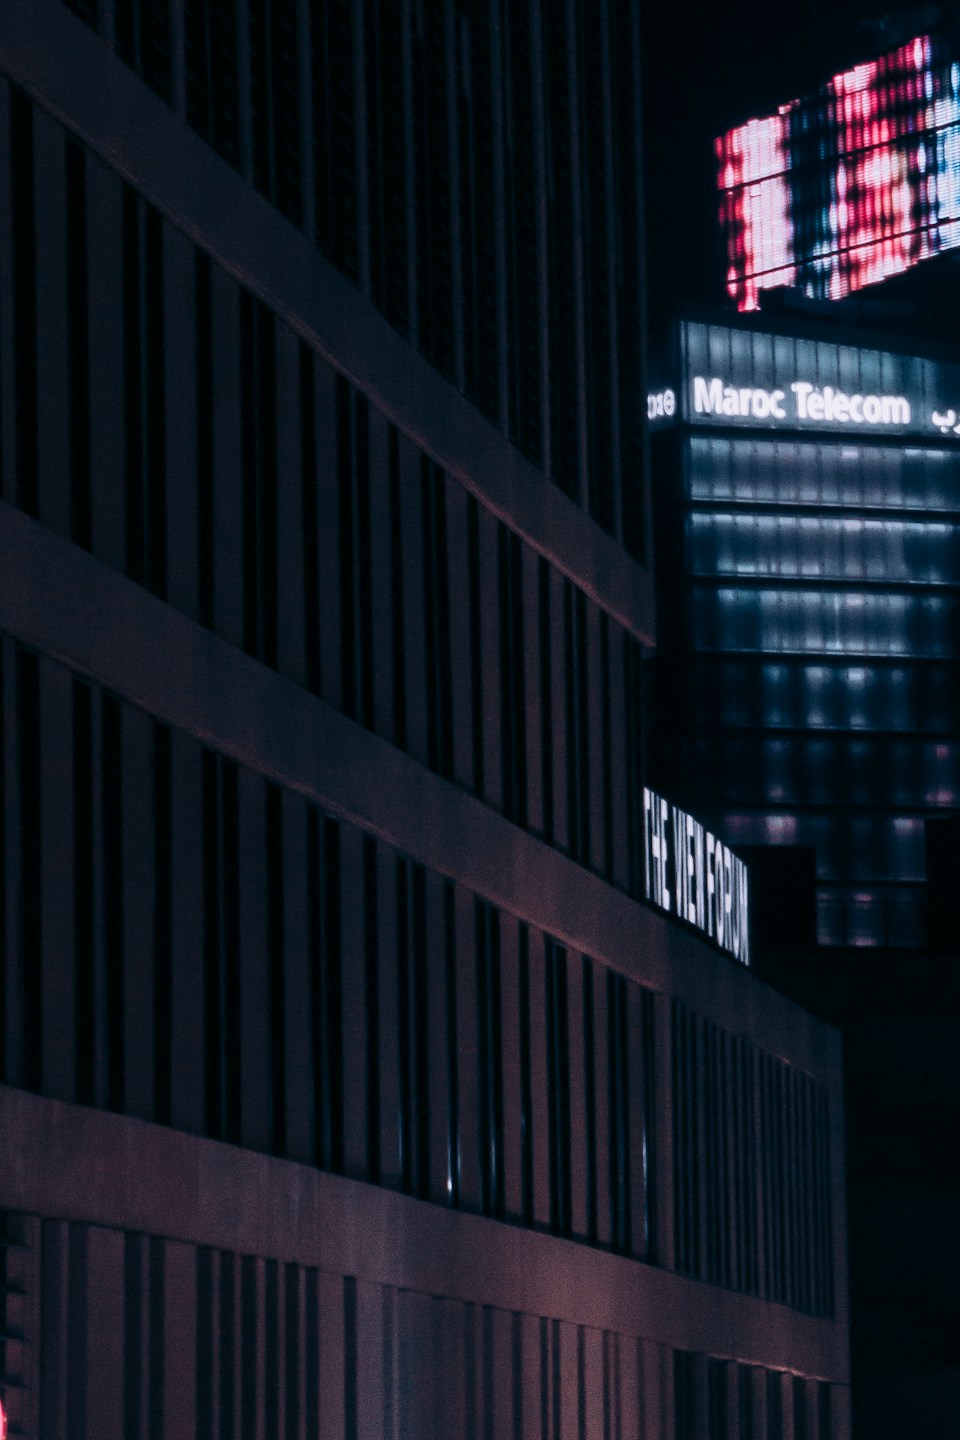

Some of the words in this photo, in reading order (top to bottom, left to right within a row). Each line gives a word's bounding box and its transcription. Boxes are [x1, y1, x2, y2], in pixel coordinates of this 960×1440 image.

[693, 376, 787, 420] Maroc
[790, 381, 912, 425] Telecom
[643, 786, 671, 912] THE
[706, 830, 751, 967] FORUM
